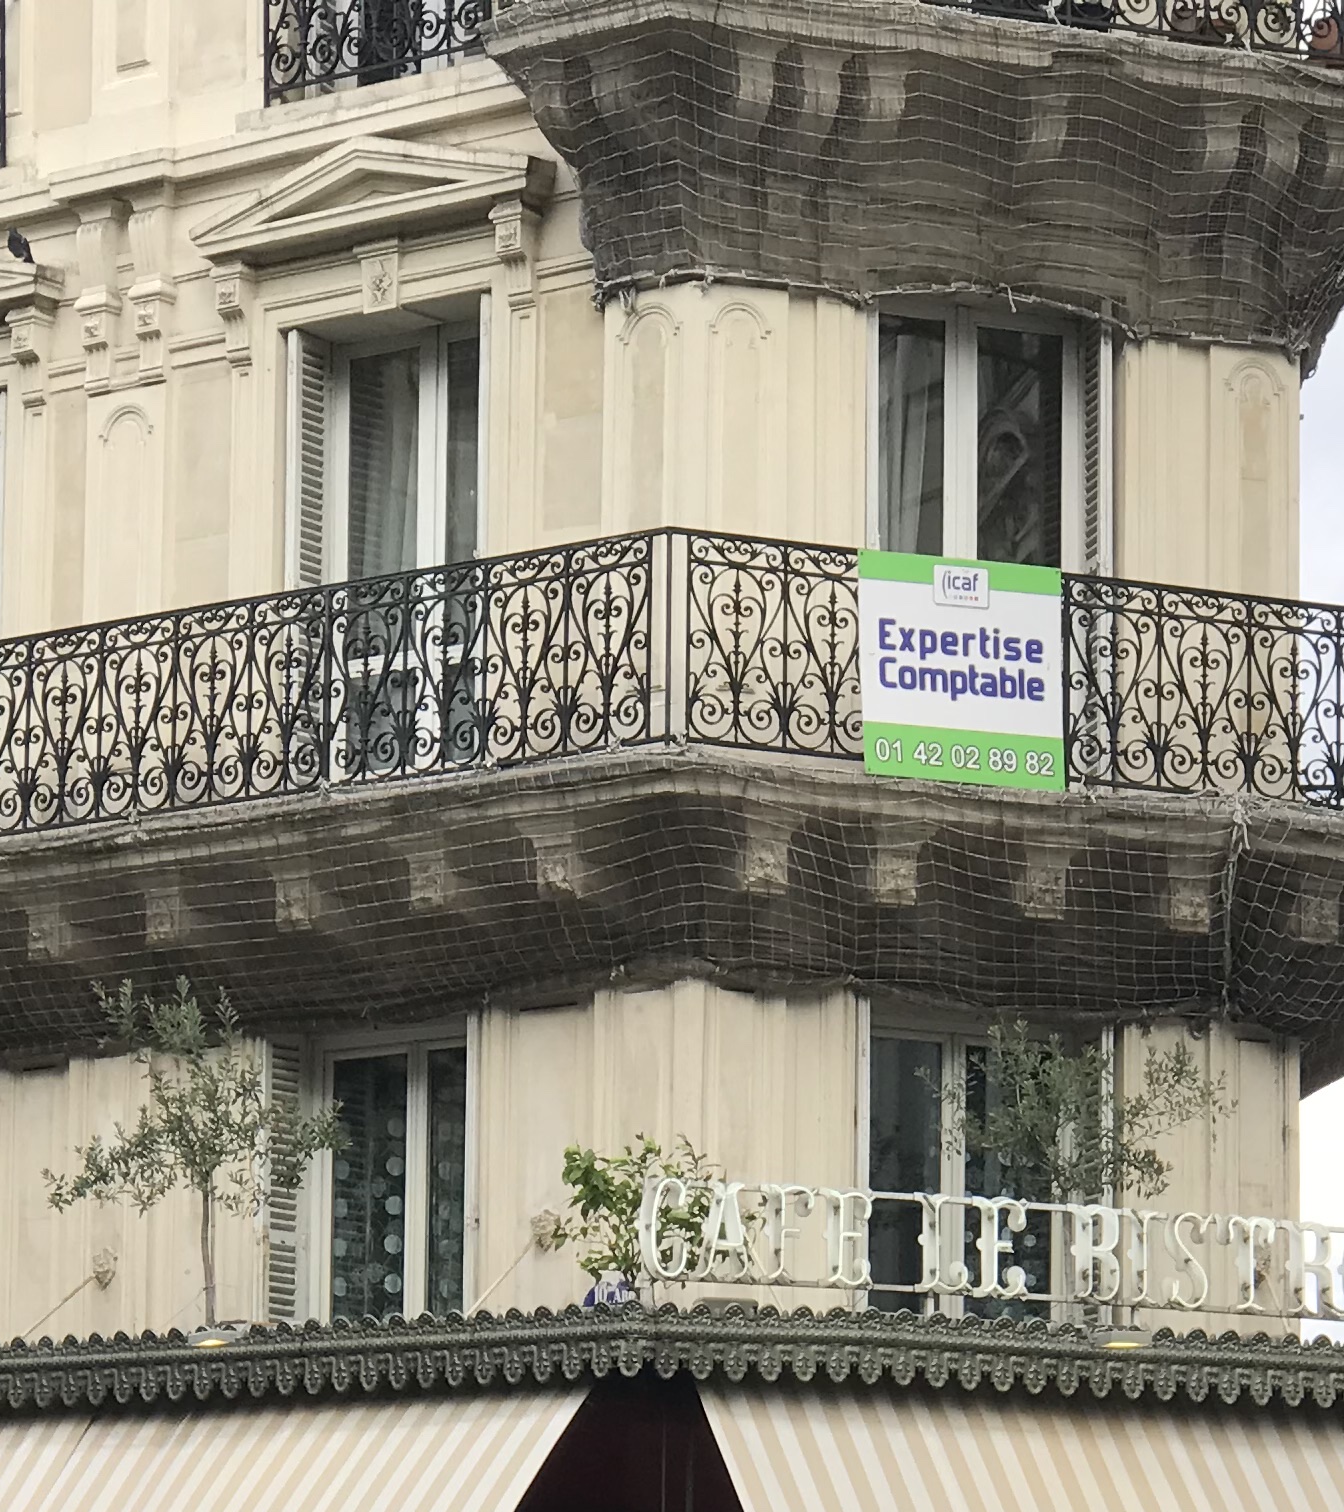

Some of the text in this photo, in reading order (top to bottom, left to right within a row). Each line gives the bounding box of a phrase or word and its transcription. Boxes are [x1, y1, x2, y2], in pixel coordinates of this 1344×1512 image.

[878, 618, 1043, 664] Expertise
[878, 657, 1045, 701] Comptable
[875, 737, 1055, 776] 01 42 02 89 82
[639, 1177, 872, 1287] CAFE
[915, 1191, 1028, 1300] LE
